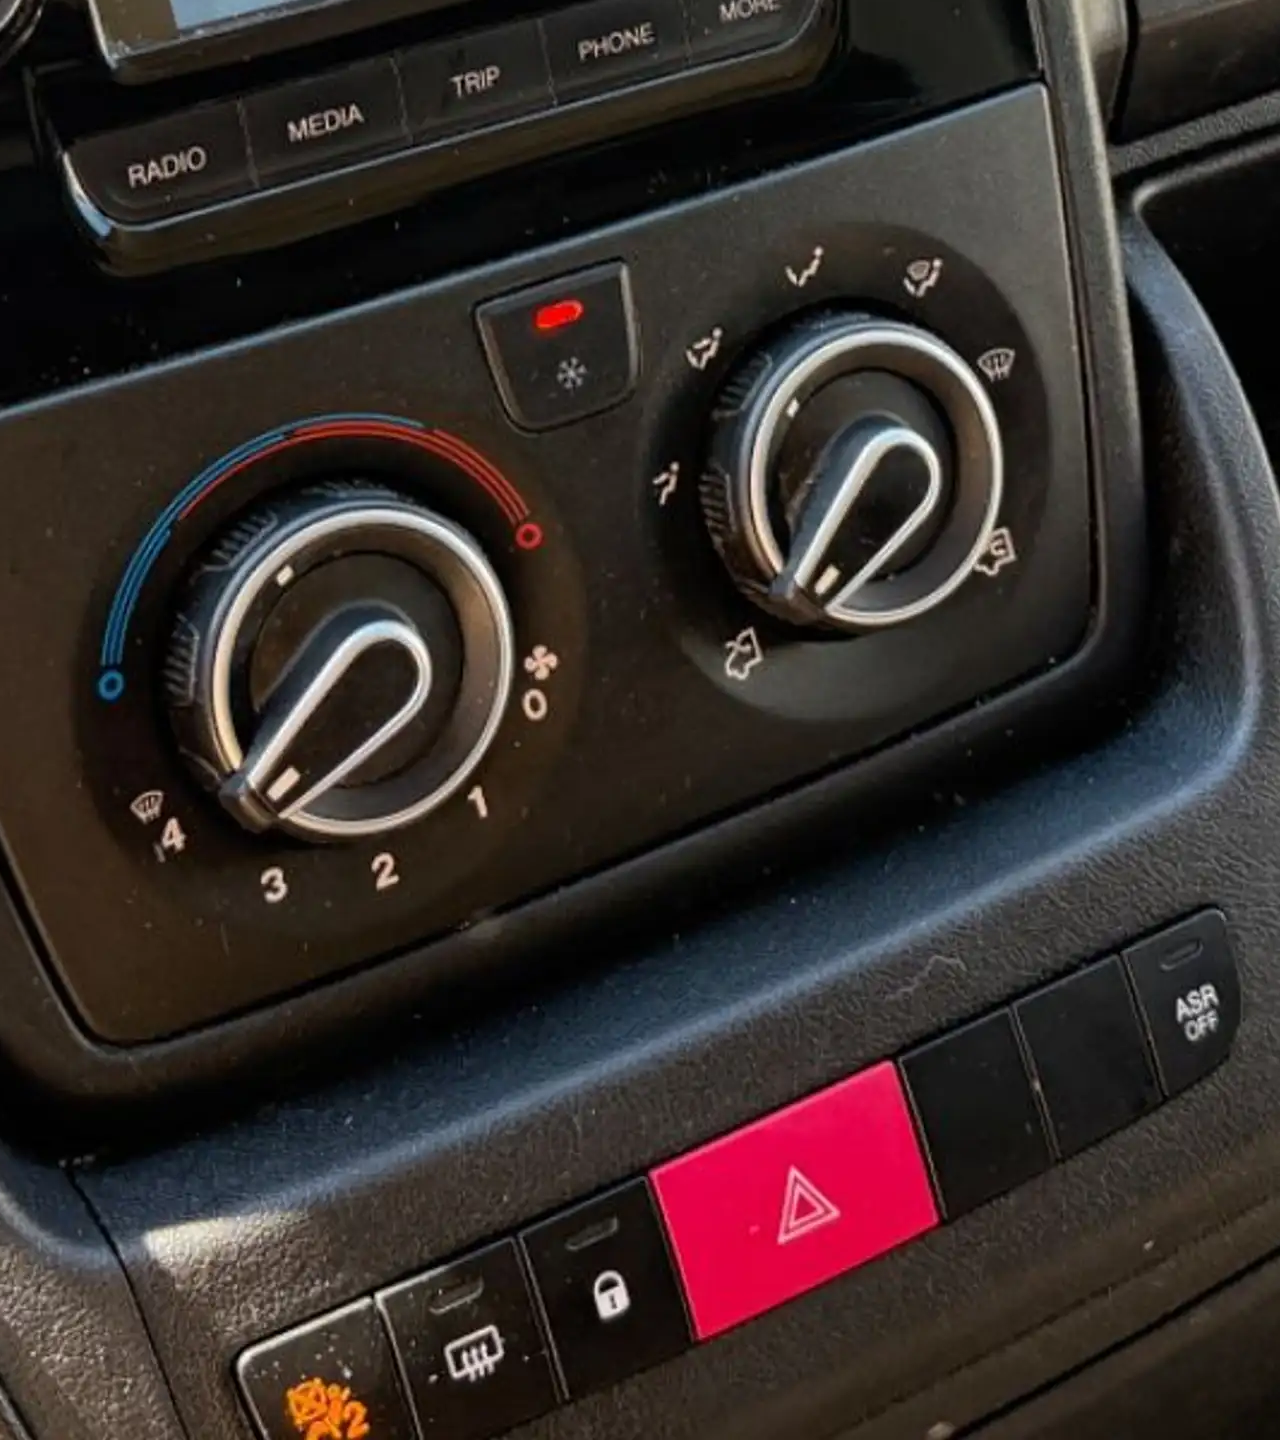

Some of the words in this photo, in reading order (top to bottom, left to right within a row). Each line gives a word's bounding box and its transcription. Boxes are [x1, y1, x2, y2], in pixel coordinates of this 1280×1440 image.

[578, 21, 657, 60] PHONE
[451, 65, 501, 98] TRIP
[287, 103, 364, 143] MEDIA
[127, 147, 207, 189] RADIO
[468, 786, 488, 820] 1
[160, 817, 186, 854] 4
[260, 867, 288, 904] 3
[371, 852, 400, 891] 2
[1175, 983, 1220, 1023] ASR
[1184, 1010, 1219, 1043] OFF
